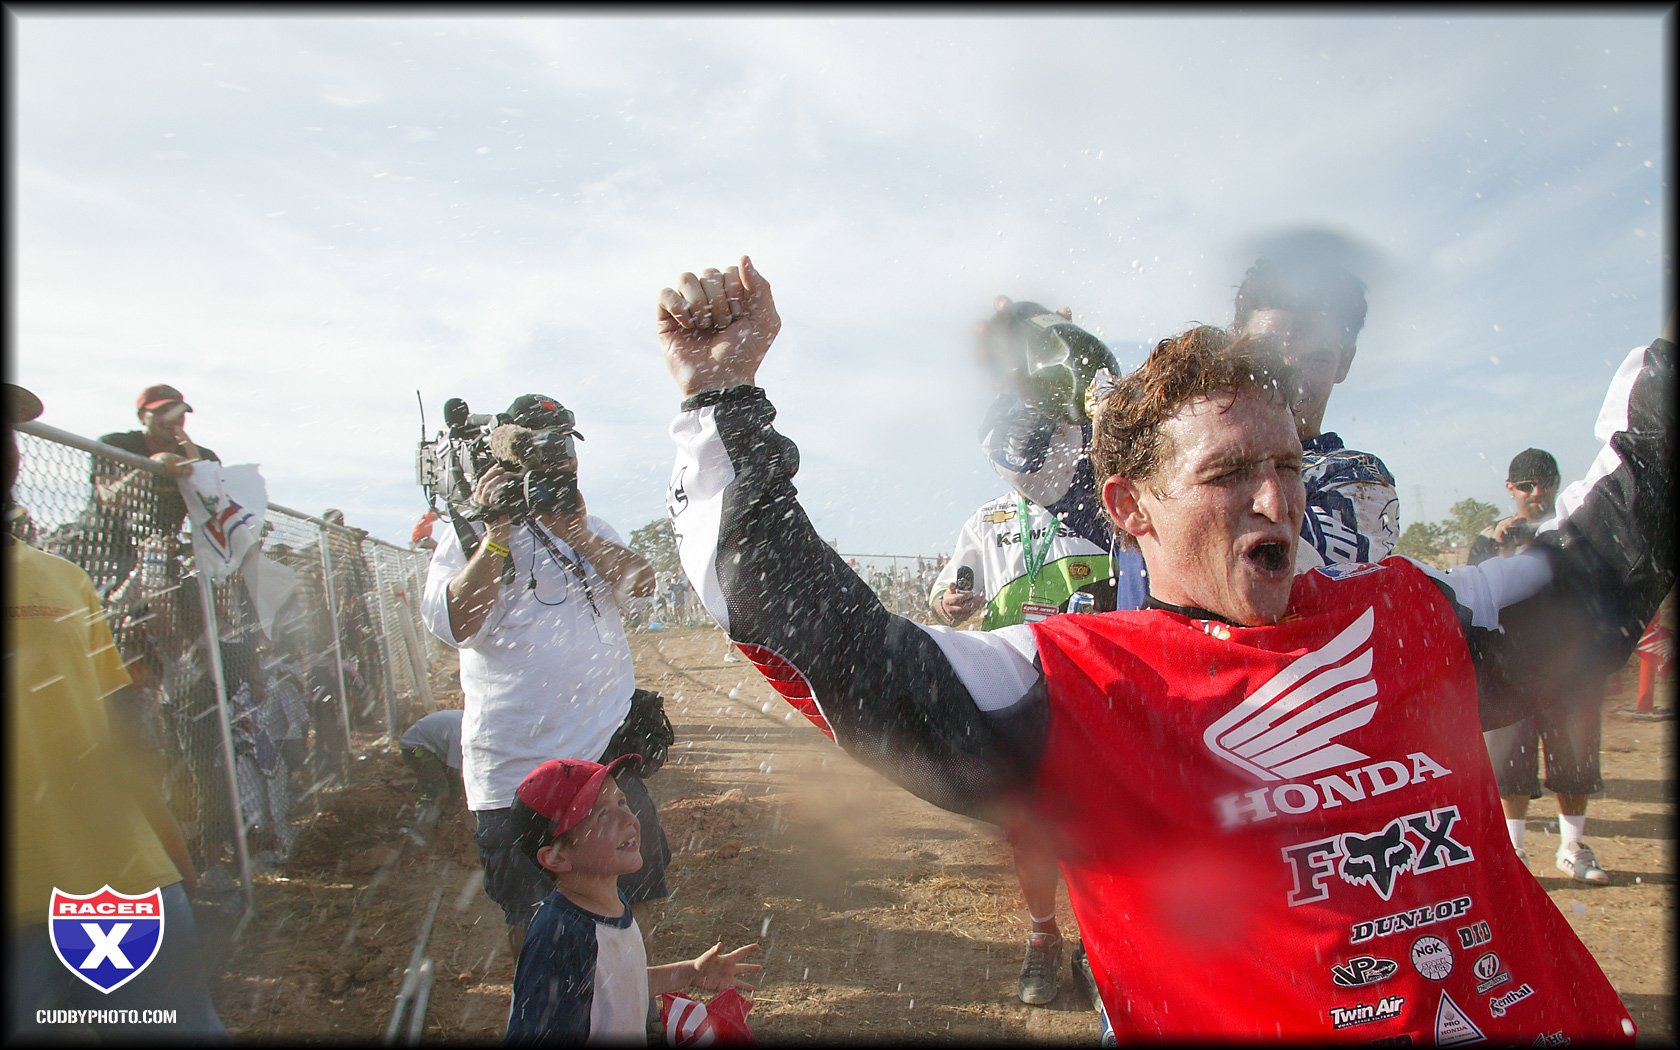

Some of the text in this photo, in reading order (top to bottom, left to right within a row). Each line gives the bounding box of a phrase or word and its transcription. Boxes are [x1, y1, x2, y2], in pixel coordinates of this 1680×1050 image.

[996, 527, 1080, 547] Kawasa
[1217, 752, 1453, 828] HONDA
[1351, 897, 1471, 944] DUNLOP
[1416, 942, 1443, 957] NGK
[1331, 956, 1377, 986] VP
[1330, 997, 1404, 1025] Twin Air
[1440, 1026, 1468, 1036] HONDA
[1444, 1020, 1460, 1028] PRO
